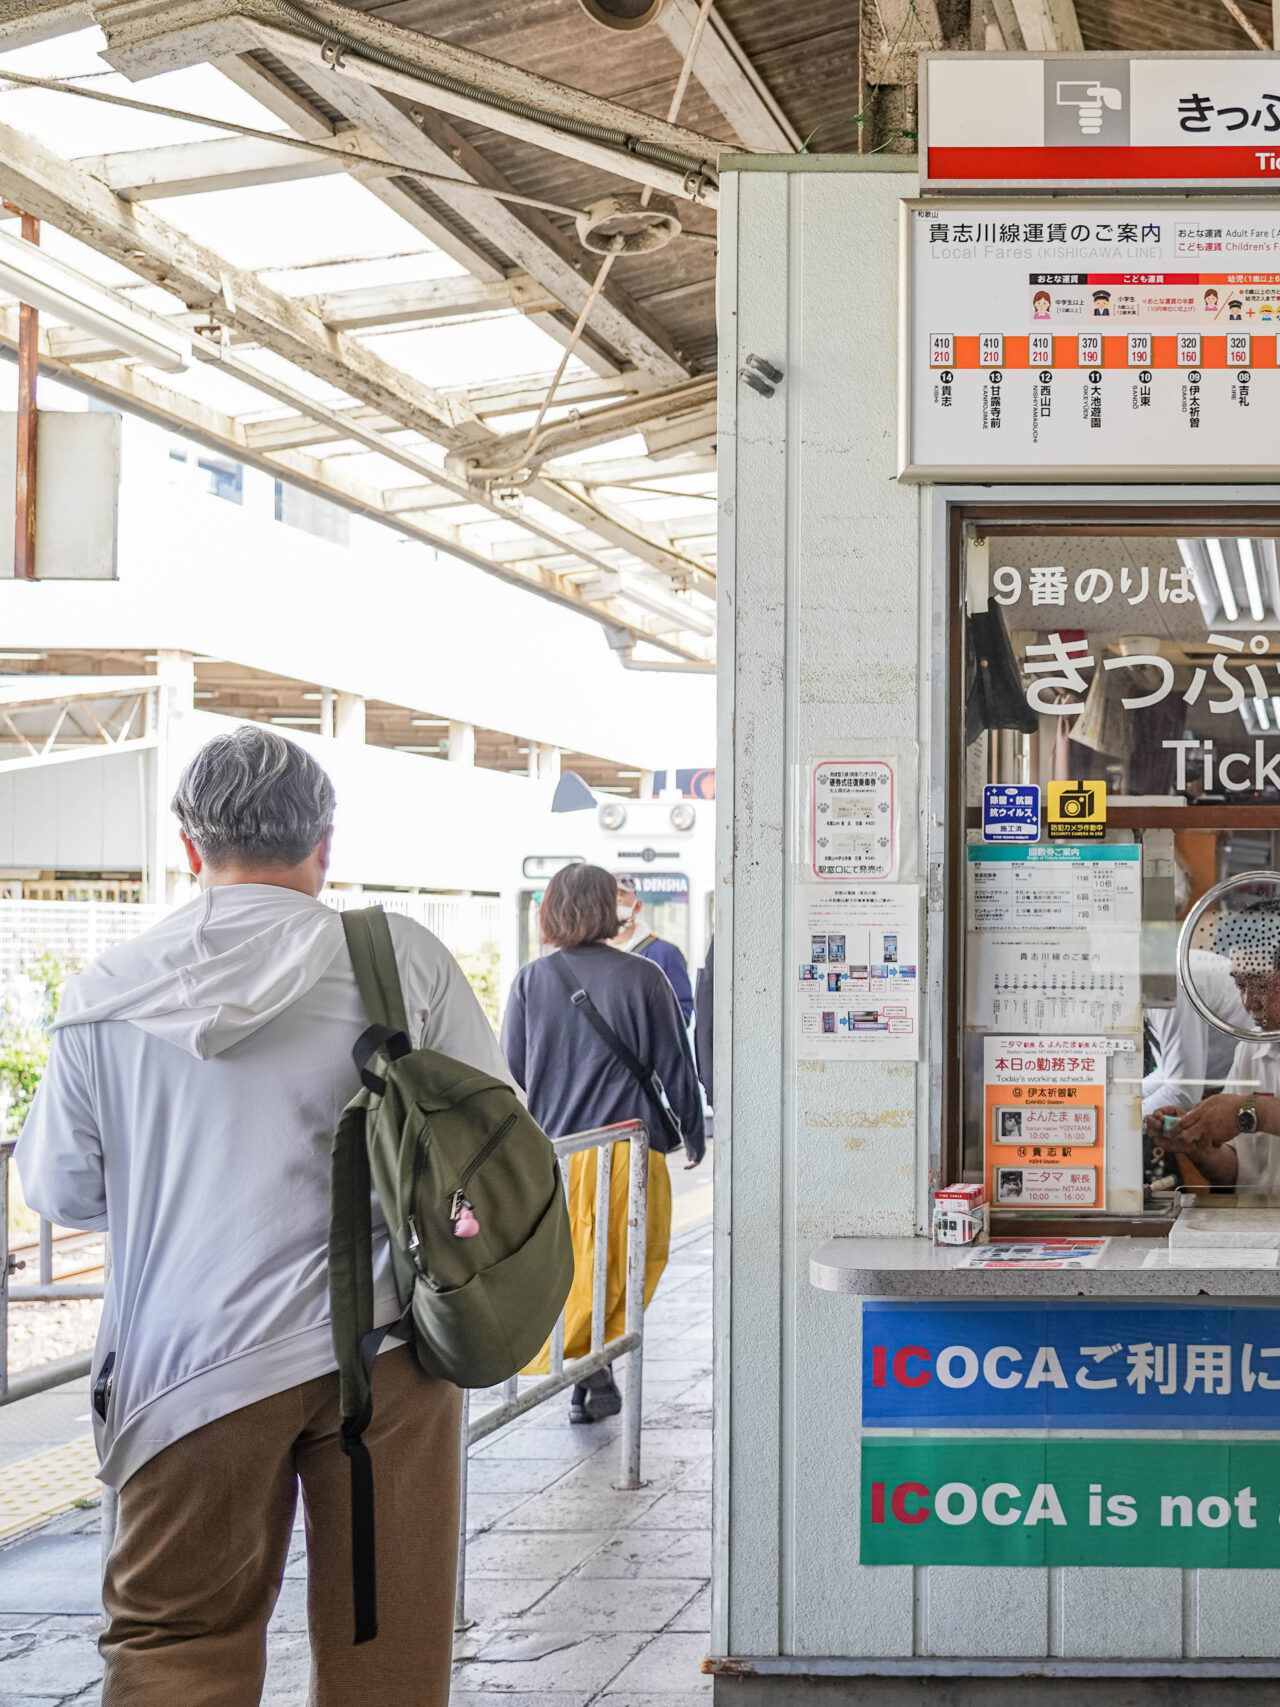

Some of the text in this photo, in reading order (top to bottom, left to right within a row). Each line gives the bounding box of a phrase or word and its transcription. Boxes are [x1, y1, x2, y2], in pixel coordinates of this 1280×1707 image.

[928, 222, 1162, 244] 貴志川線運賃のご案内
[1178, 229, 1222, 238] おとな運賃
[1225, 229, 1249, 238] Adult
[1251, 229, 1269, 238] Fare
[930, 245, 1163, 260] Local Fares (KISHIGAWA LINE)
[1178, 242, 1222, 251] こども運賃
[1225, 242, 1271, 251] Children's
[1037, 274, 1079, 284] おとな運賃
[1123, 274, 1164, 284] こども運賃
[934, 338, 950, 348] 410
[1181, 338, 1197, 348] 320
[934, 352, 950, 362] 210
[1181, 352, 1197, 362] 160
[1189, 372, 1200, 381] 09
[941, 386, 952, 407] 貴志
[1040, 386, 1051, 417] 西山口
[1140, 386, 1151, 407] 山東
[1239, 385, 1250, 407] 吉礼
[990, 386, 1001, 428] 甘露寺前
[1090, 386, 1101, 428] 大池遊園
[993, 565, 1196, 606] 9番のりば
[989, 808, 1033, 817] 抗ウイルス
[643, 878, 688, 892] DENSHA
[994, 1057, 1096, 1072] 本日の勤務予定
[996, 1074, 1094, 1084] Today's working schedule
[1026, 1110, 1068, 1123] よんたま
[1028, 1132, 1085, 1140] 10:00 16:00
[1026, 1171, 1064, 1183] ニタマ
[870, 1482, 1068, 1528] ICOCA
[1088, 1482, 1139, 1528] is
[1159, 1485, 1258, 1529] not
